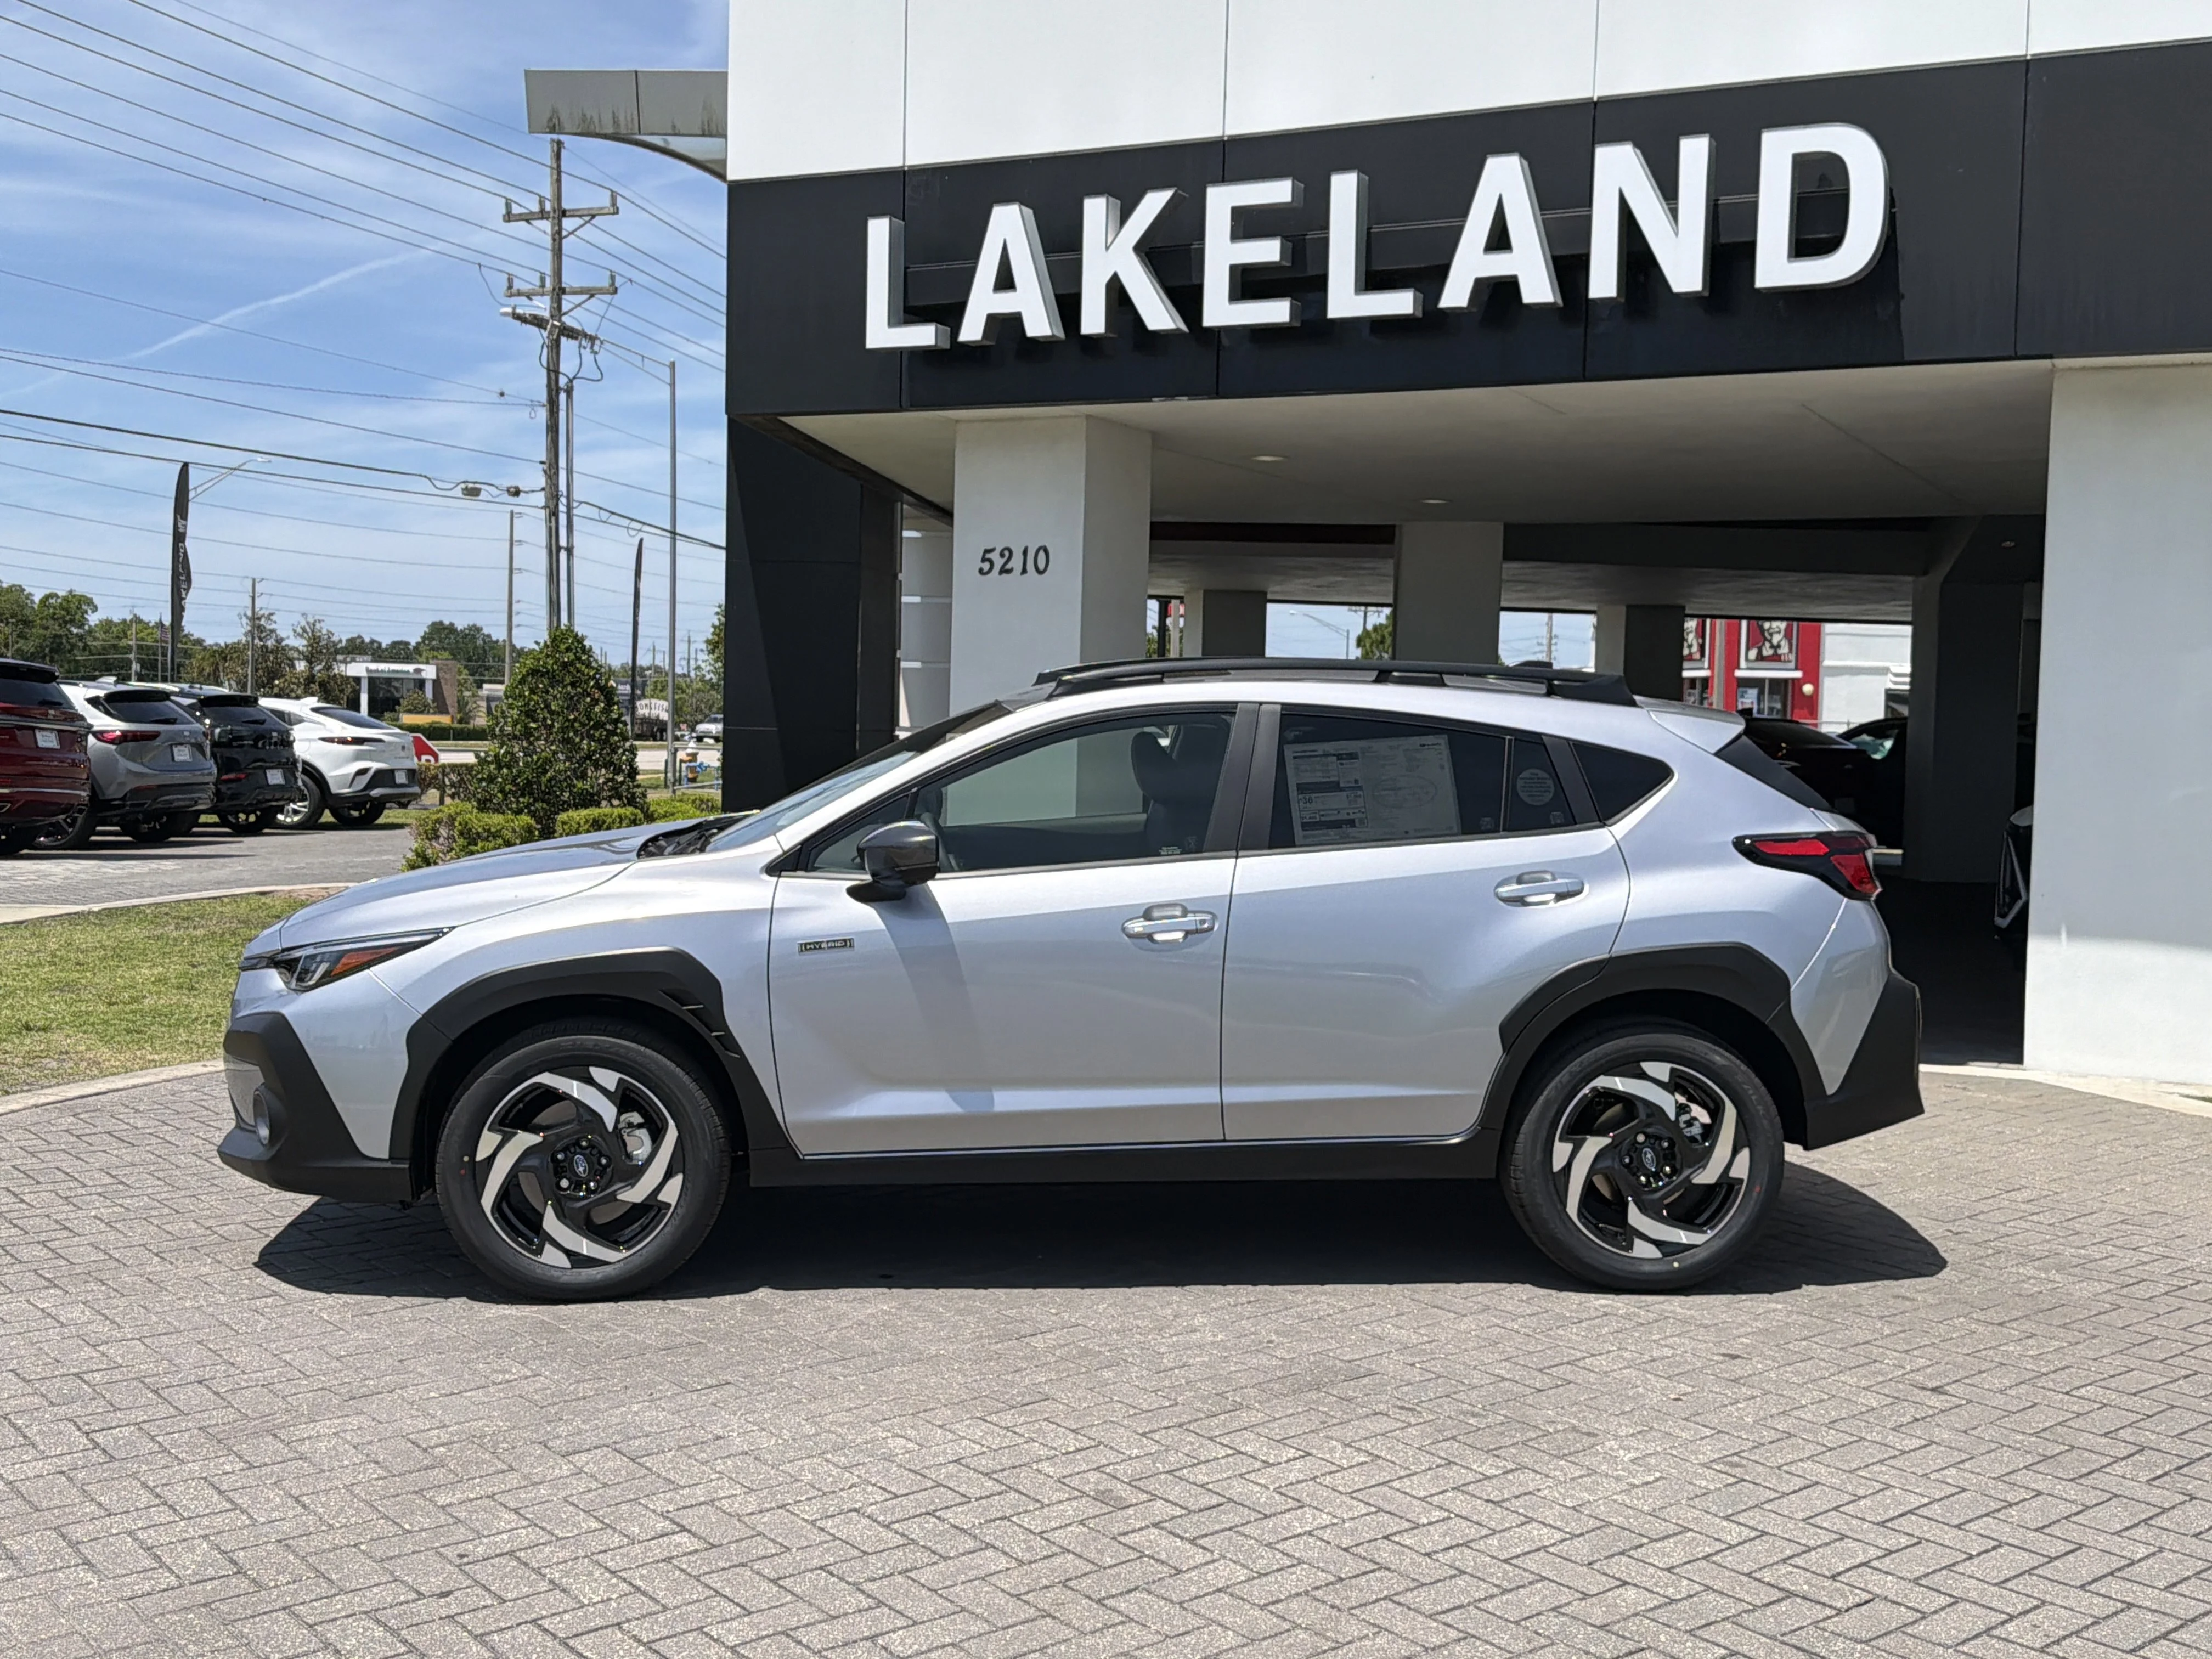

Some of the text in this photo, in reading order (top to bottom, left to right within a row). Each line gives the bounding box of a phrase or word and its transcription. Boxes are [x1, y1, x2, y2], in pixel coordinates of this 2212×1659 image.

[865, 122, 1891, 350] LAKELAND
[978, 544, 1050, 576] 5210
[806, 940, 845, 950] HYBRID
